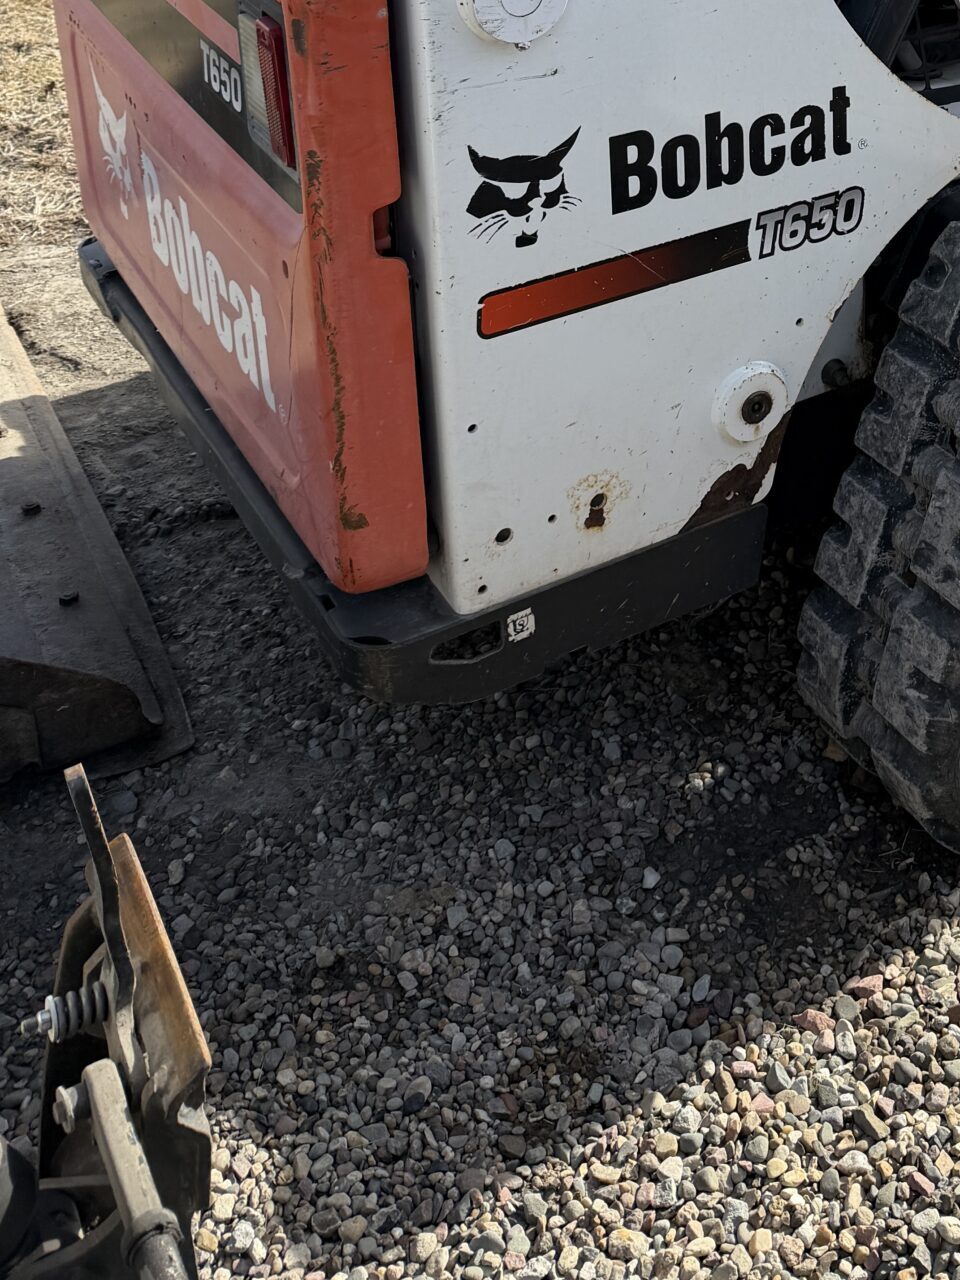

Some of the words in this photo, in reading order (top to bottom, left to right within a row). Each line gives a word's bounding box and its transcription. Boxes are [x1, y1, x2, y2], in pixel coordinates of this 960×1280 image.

[200, 39, 243, 114] T650
[608, 85, 852, 216] Bobcat
[754, 184, 866, 260] T650
[140, 149, 276, 413] Bobcat
